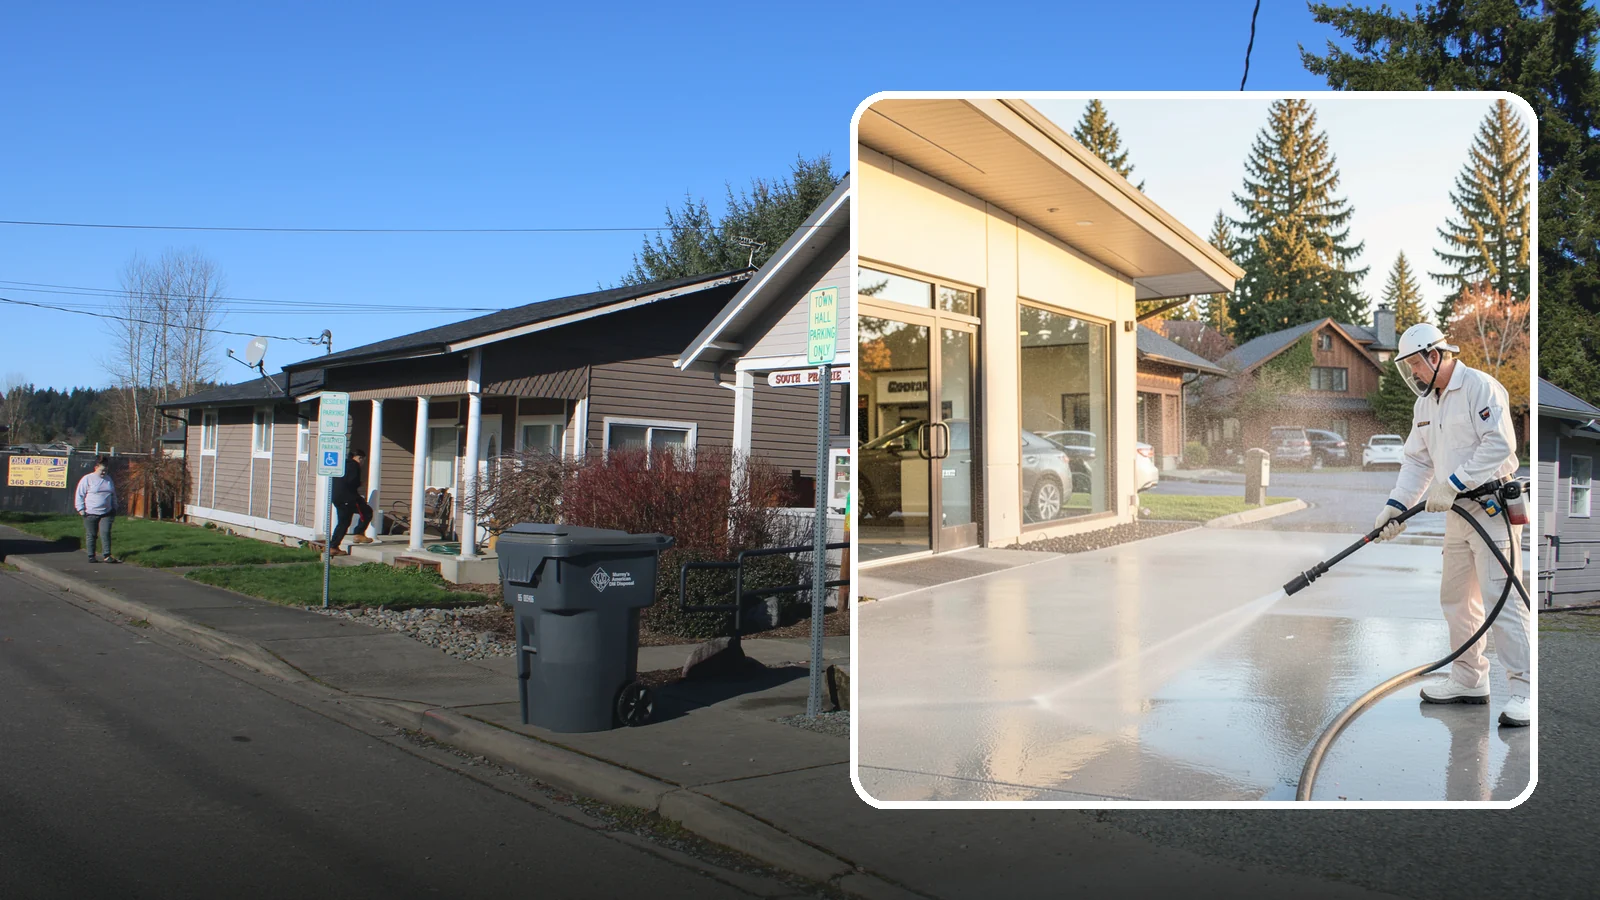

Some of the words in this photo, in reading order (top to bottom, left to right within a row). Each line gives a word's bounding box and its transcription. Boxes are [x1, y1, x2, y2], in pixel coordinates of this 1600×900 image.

[815, 294, 832, 308] TOWN
[814, 312, 831, 324] HALL
[810, 326, 836, 340] PARKING
[814, 344, 830, 357] ONLY
[776, 374, 801, 384] SOUTH
[808, 371, 841, 382] PRIE
